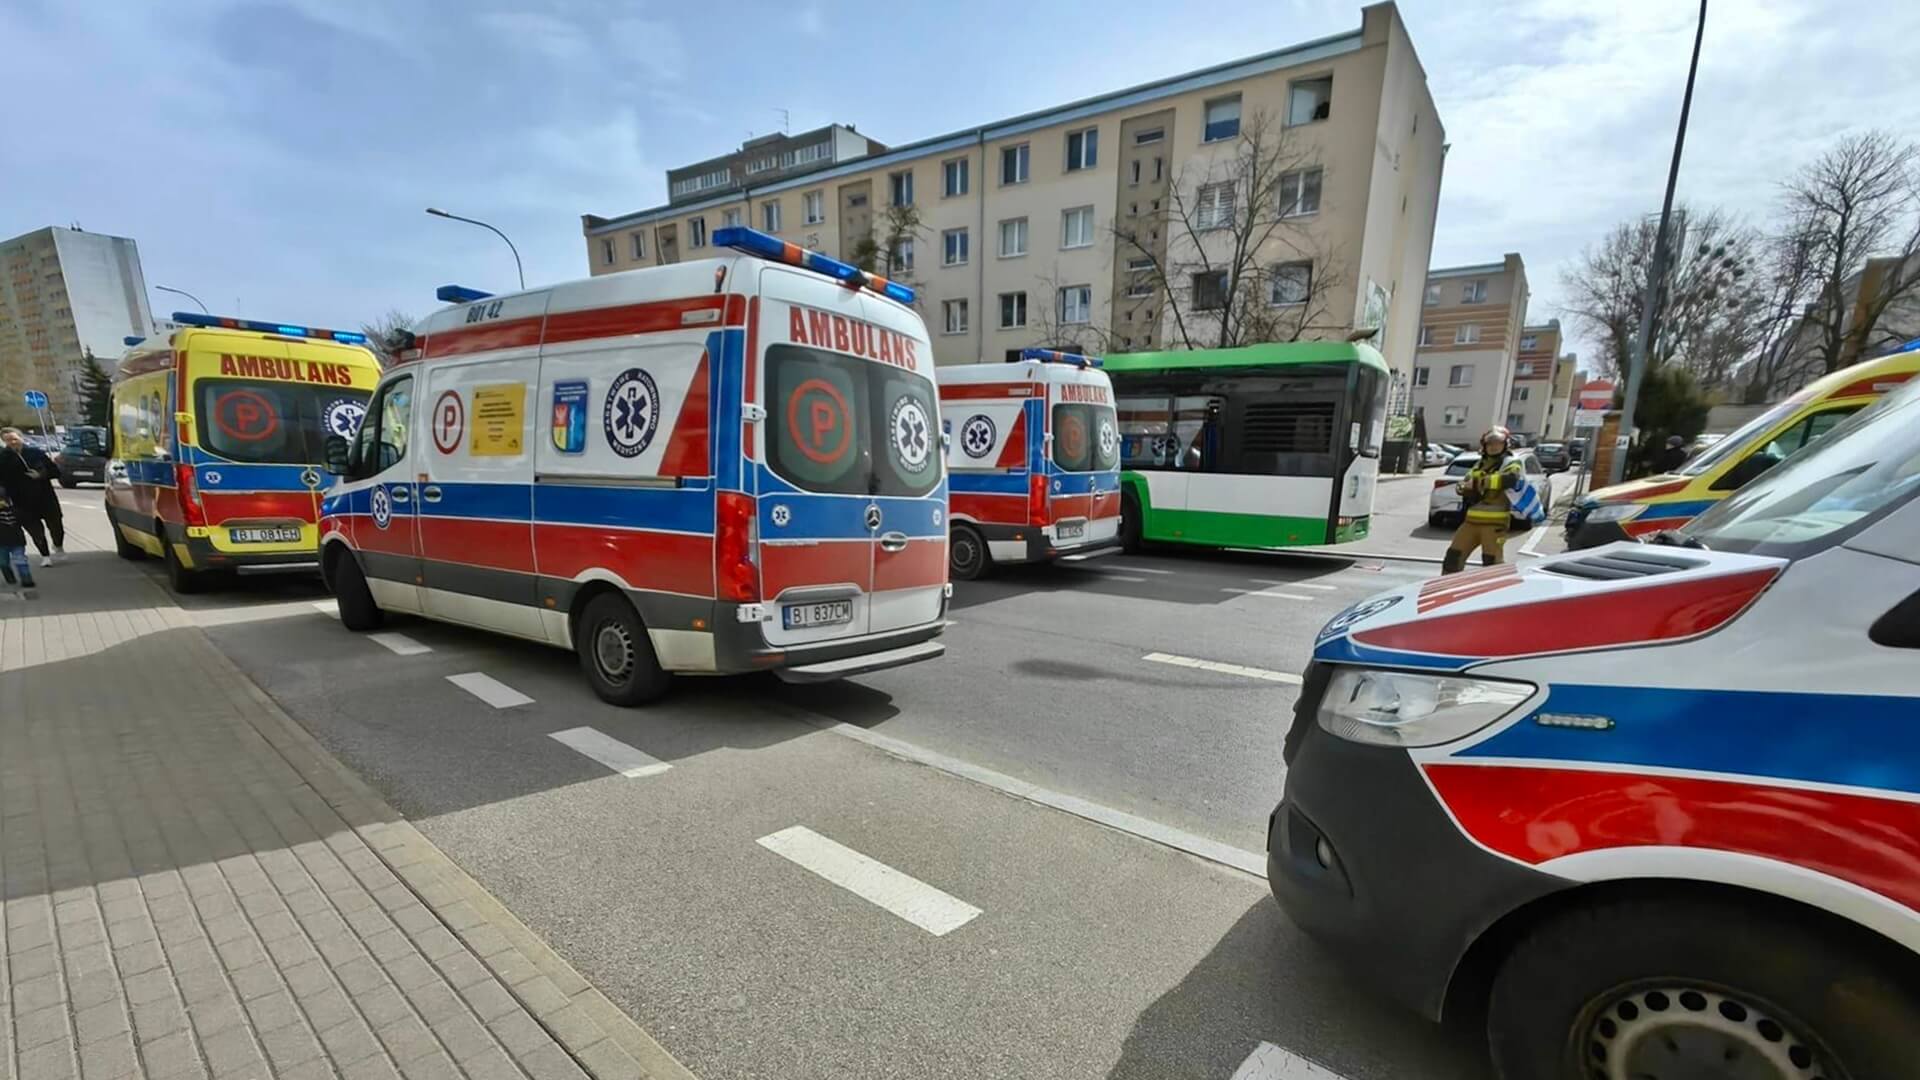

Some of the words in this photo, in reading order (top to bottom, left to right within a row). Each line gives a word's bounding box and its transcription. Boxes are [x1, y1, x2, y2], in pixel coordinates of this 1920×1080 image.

[790, 306, 917, 369] AMBULANS
[220, 353, 352, 386] AMBULANS
[235, 403, 260, 431] P
[443, 405, 456, 442] P
[810, 400, 836, 447] P
[239, 530, 253, 541] BI
[793, 608, 808, 624] BI
